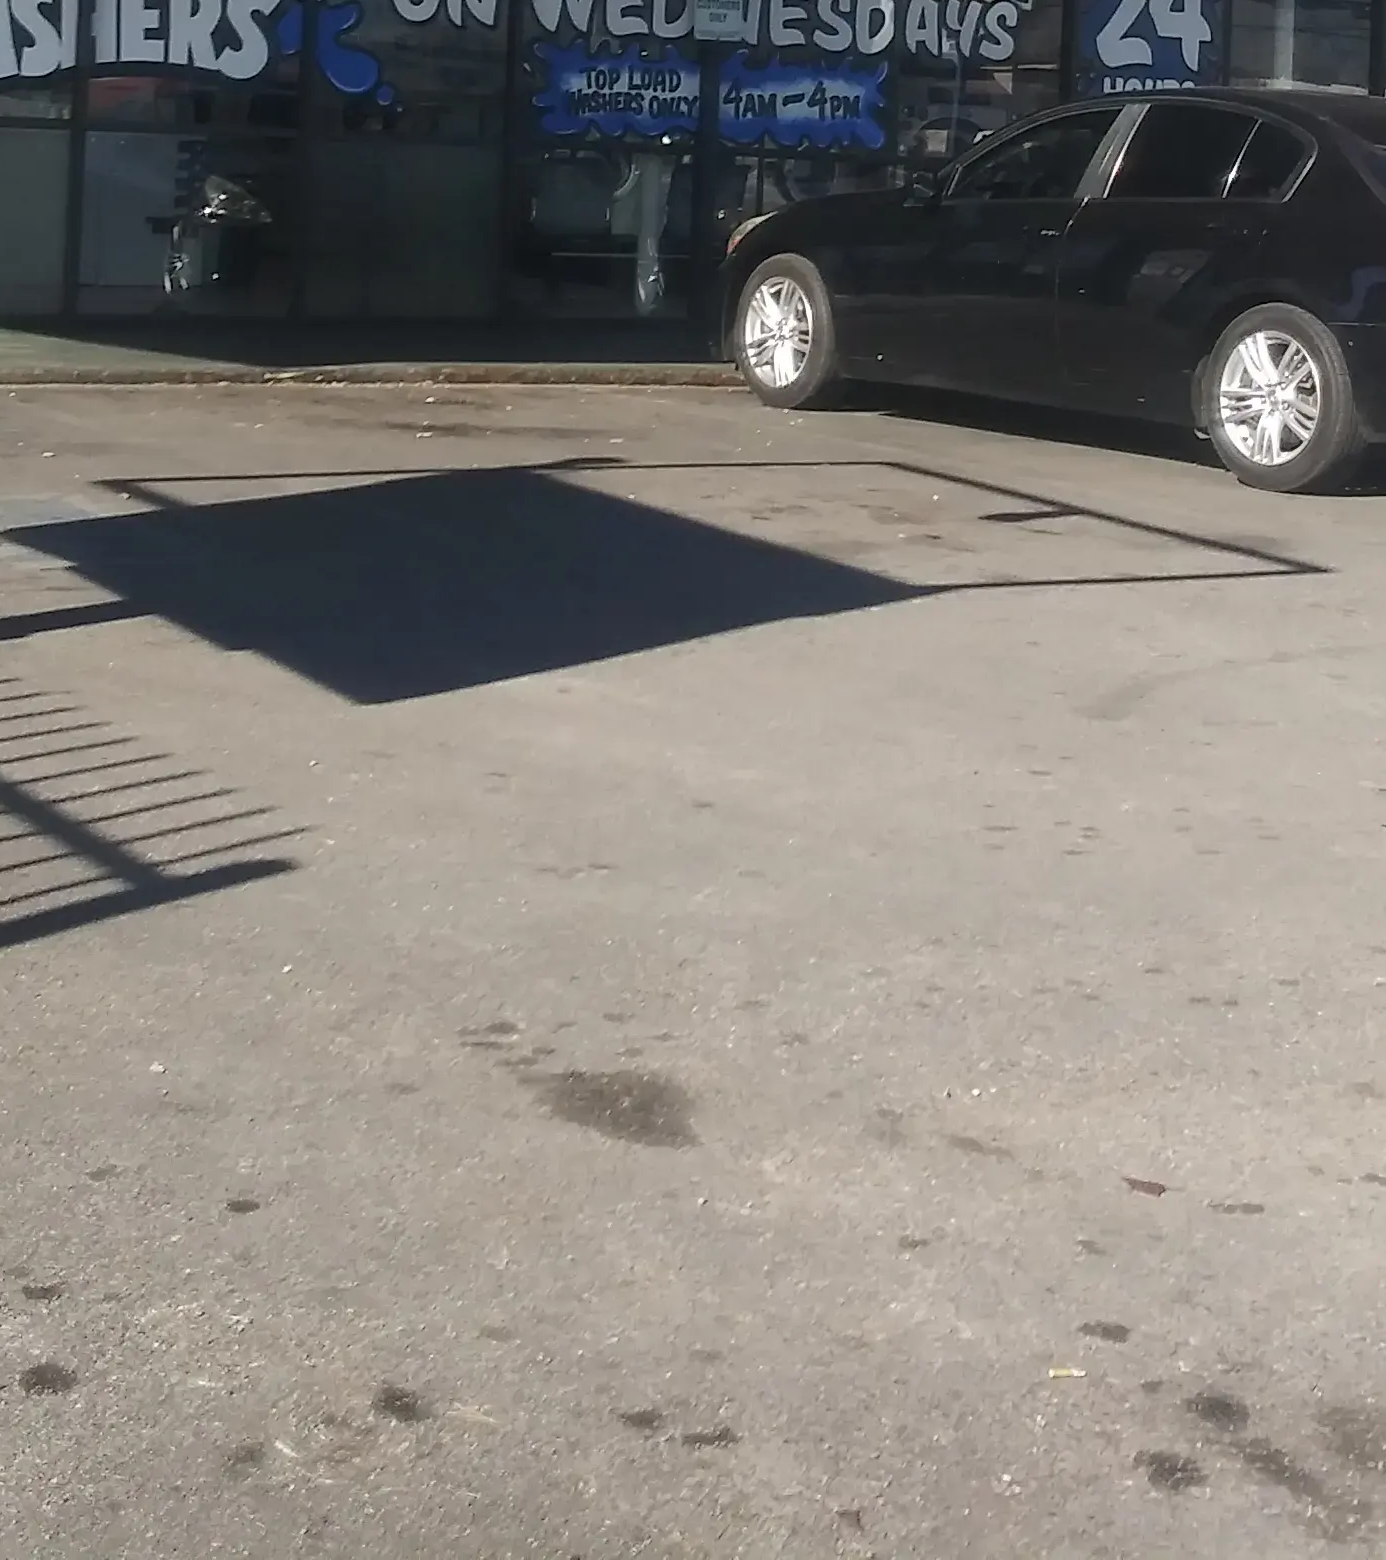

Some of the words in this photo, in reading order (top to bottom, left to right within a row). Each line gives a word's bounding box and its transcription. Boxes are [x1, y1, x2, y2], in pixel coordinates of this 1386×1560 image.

[580, 65, 621, 92] TOP
[627, 65, 683, 93] LOAD
[568, 89, 645, 116] WASHERS
[648, 93, 701, 119] ONLY
